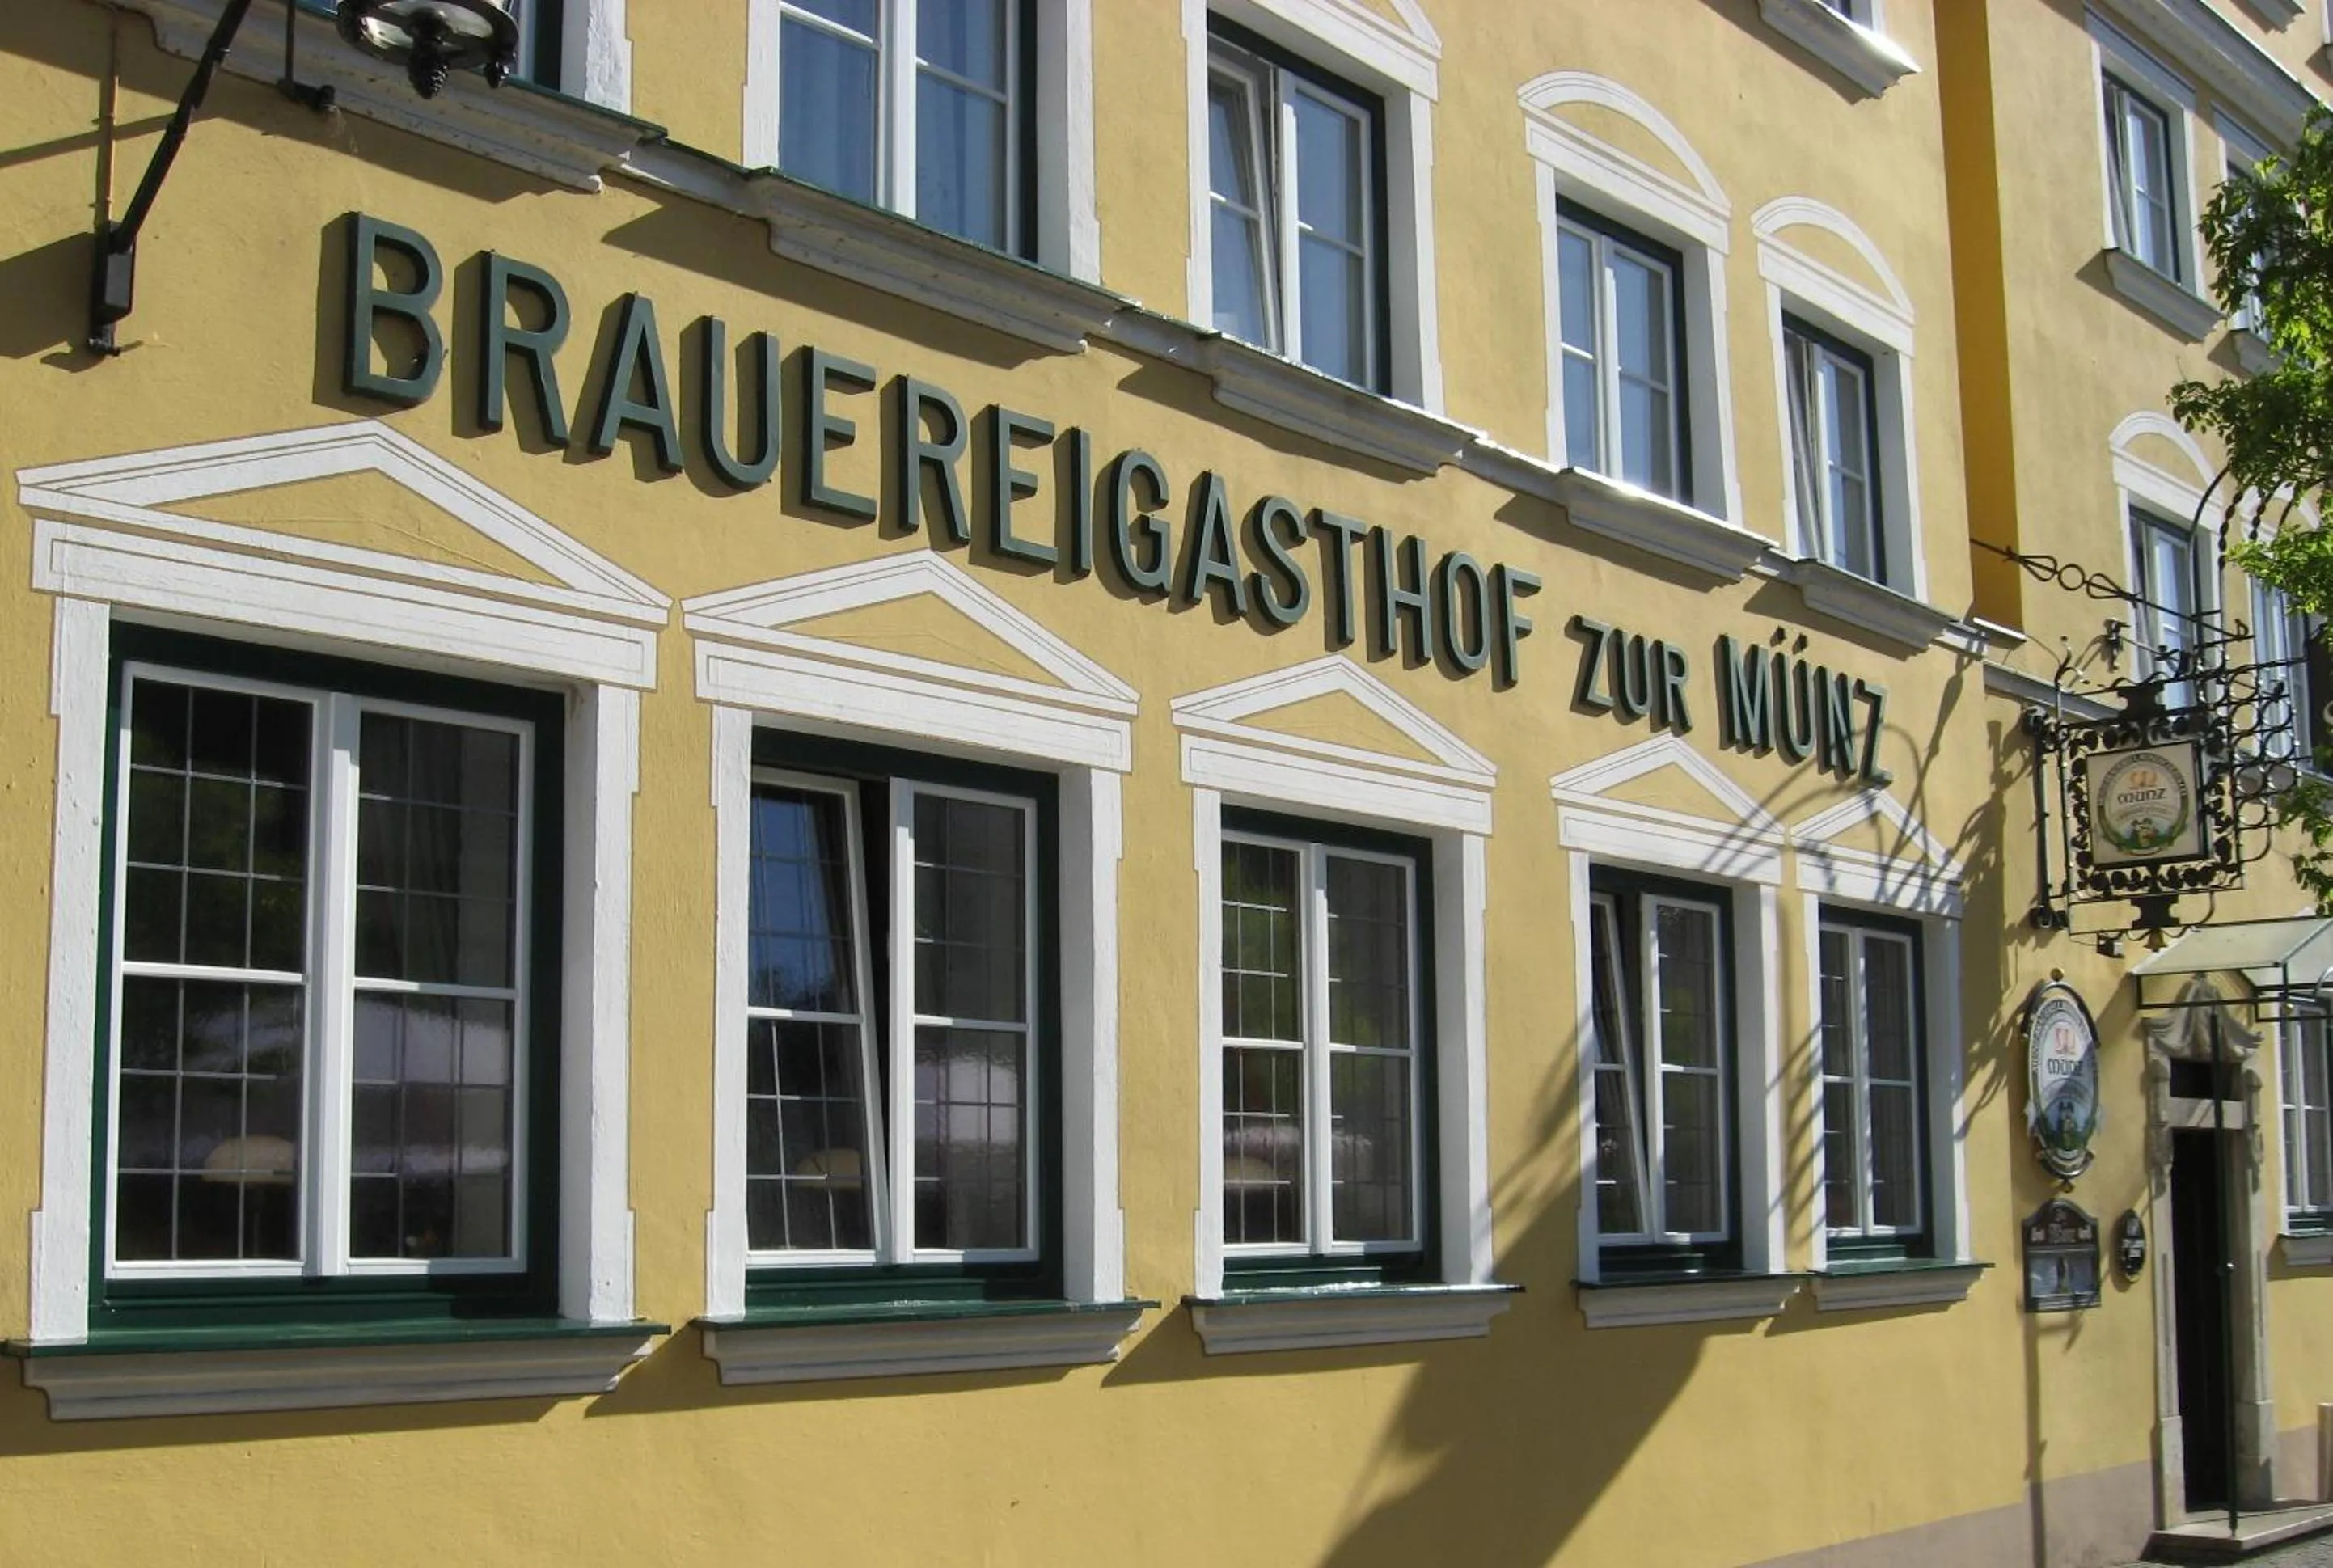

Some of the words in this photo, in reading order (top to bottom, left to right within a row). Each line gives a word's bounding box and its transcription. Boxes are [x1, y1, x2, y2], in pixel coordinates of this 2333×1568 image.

[344, 211, 1542, 687] BRAUEREIGASTHOF
[1574, 615, 1692, 735] ZUR
[1717, 627, 1893, 785] MÜNZ
